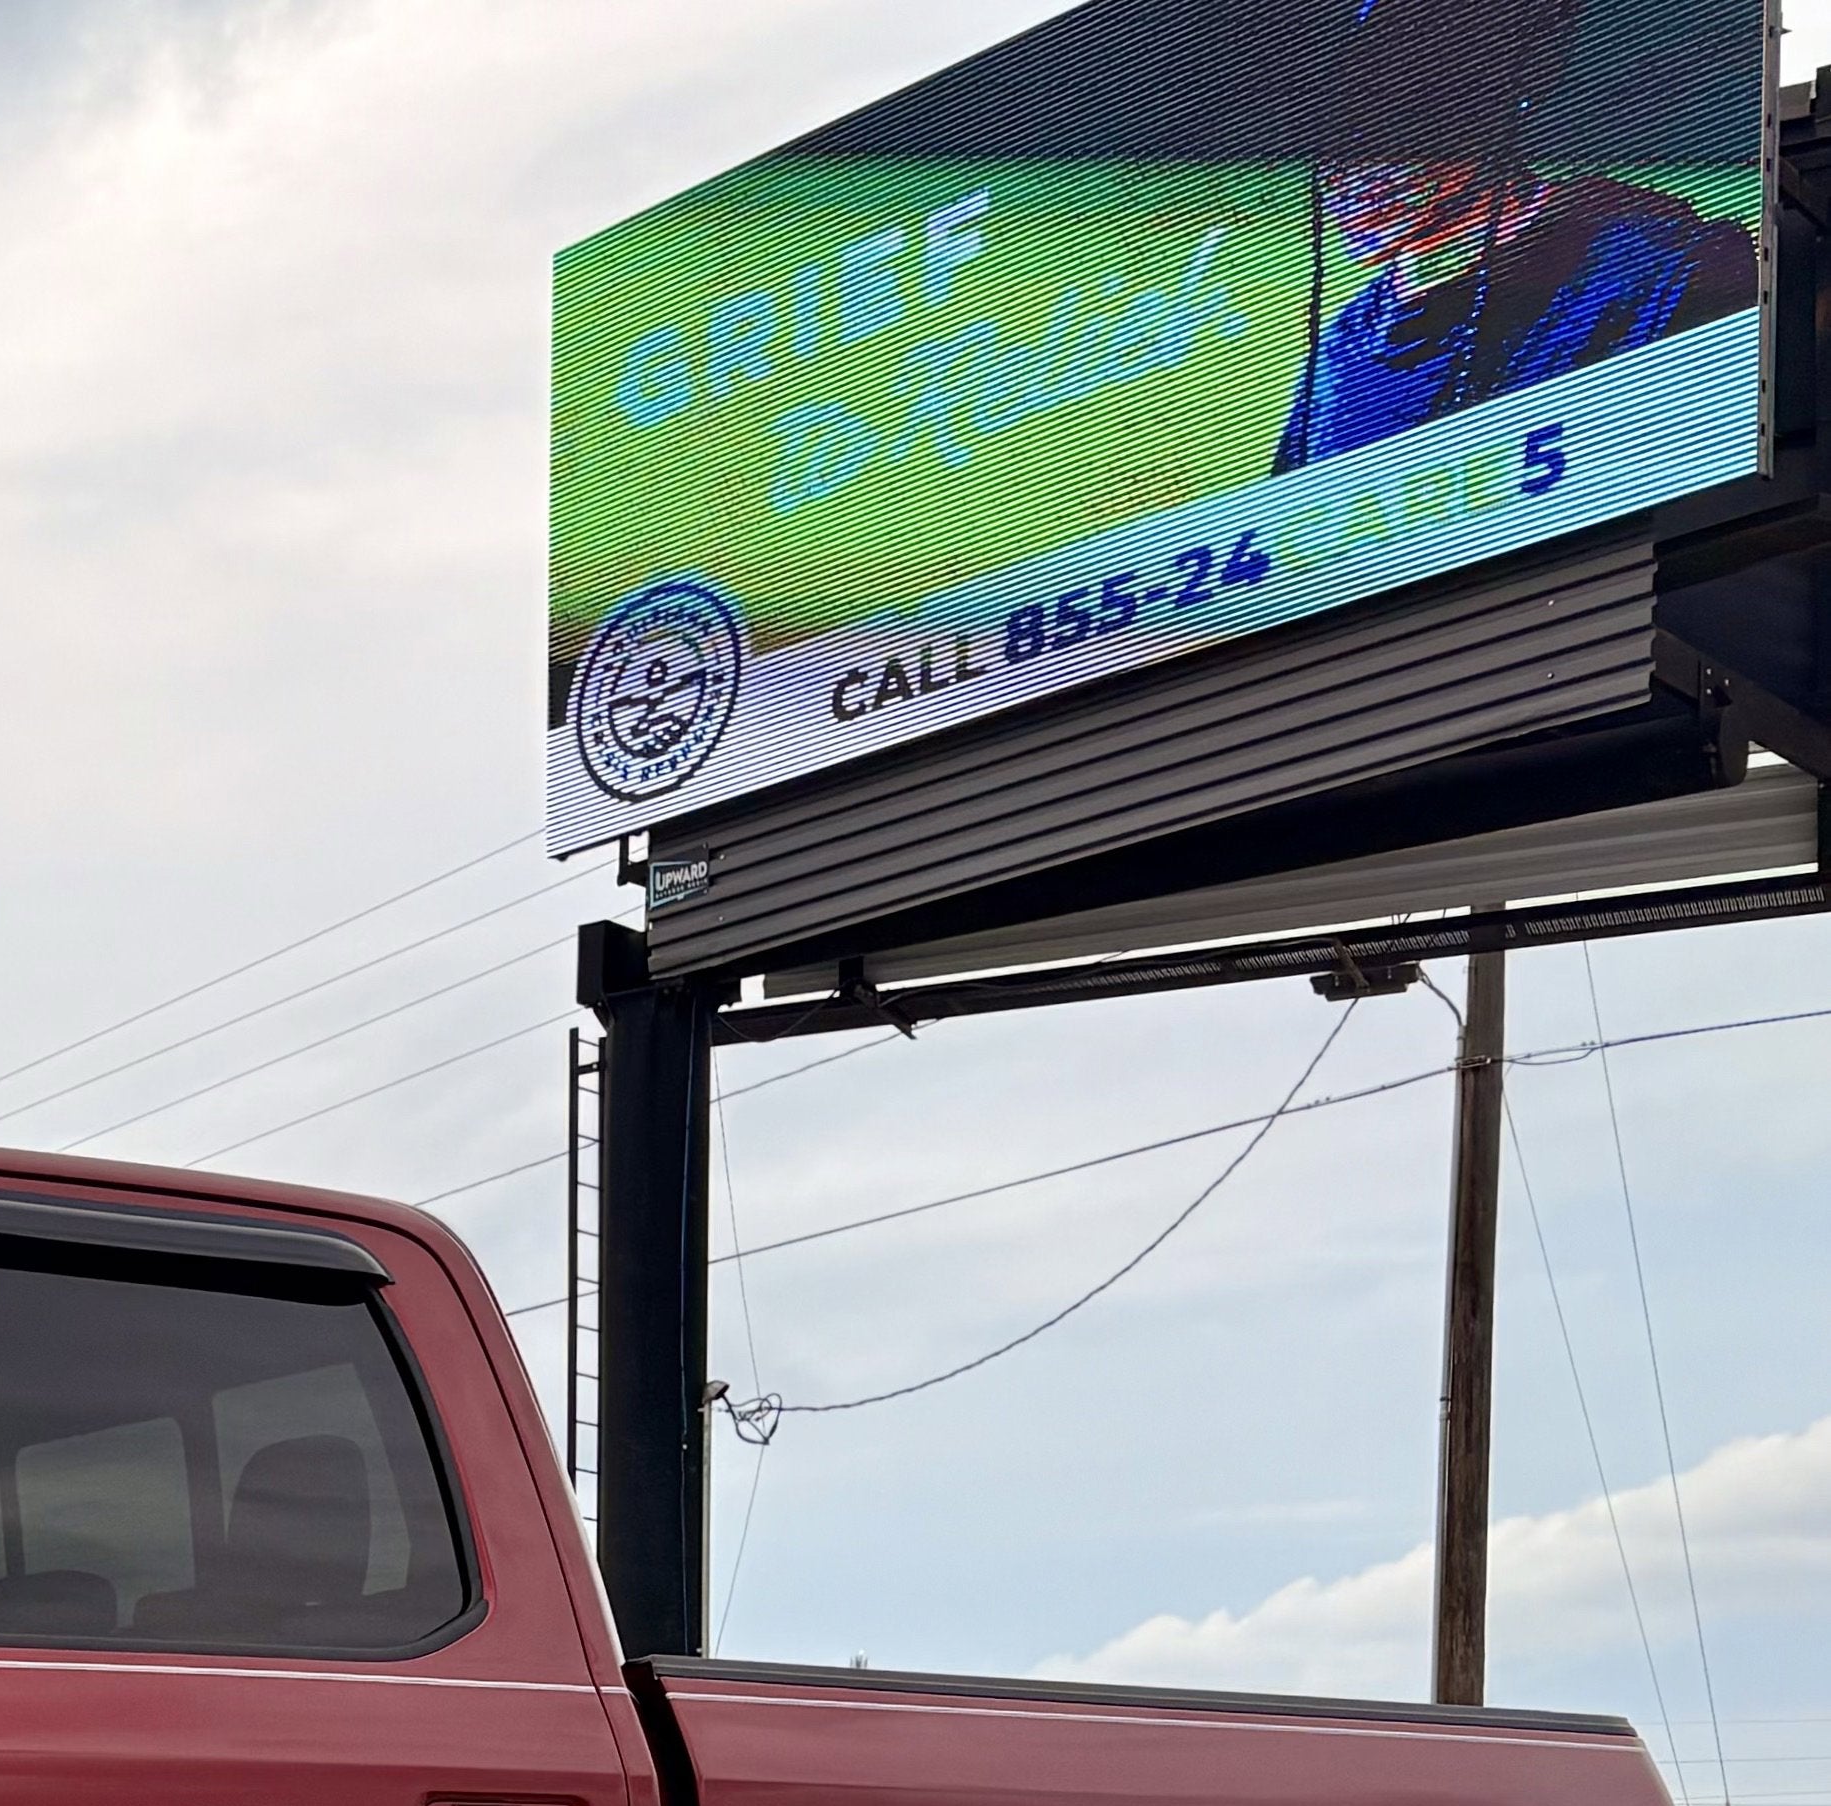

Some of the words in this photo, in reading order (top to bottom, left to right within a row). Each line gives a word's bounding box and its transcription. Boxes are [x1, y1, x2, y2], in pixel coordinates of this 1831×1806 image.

[615, 188, 991, 428] GRIEF
[832, 634, 989, 721] CALL
[655, 861, 708, 892] UPWARD
